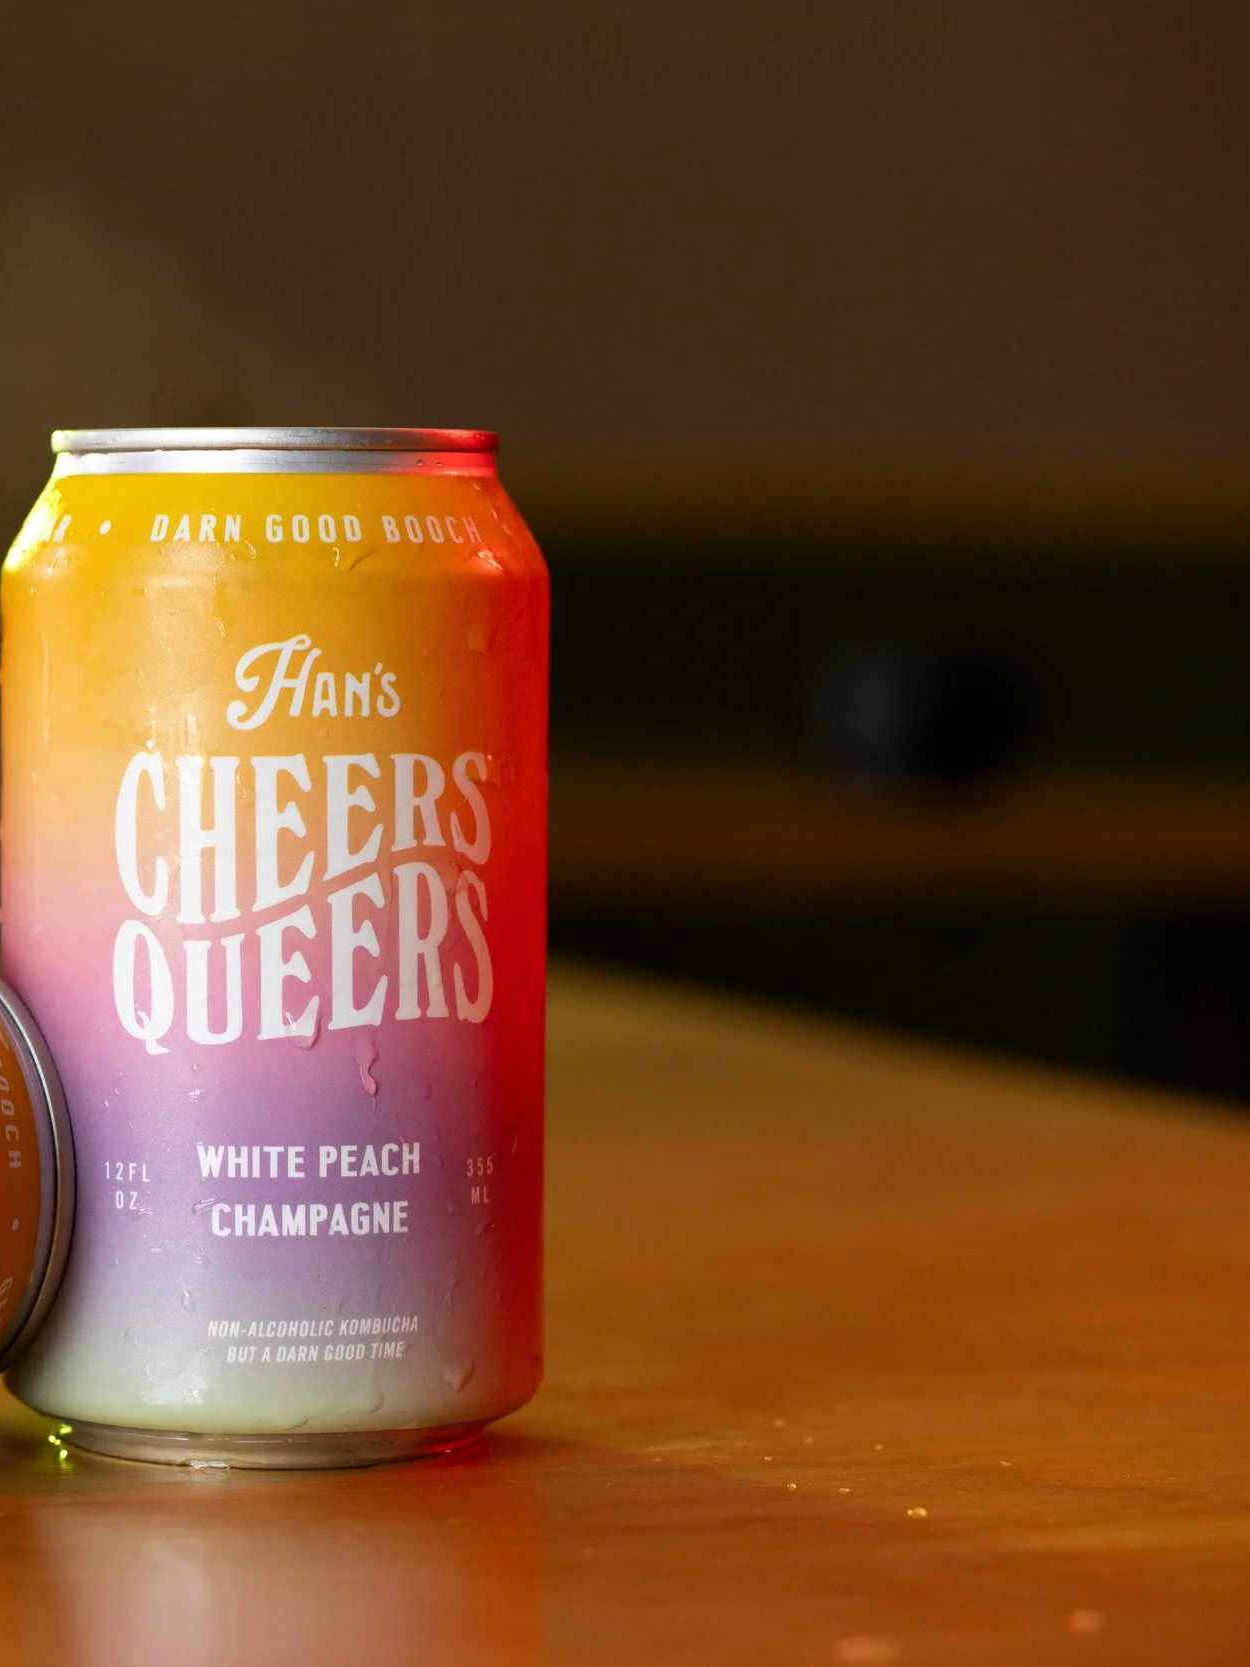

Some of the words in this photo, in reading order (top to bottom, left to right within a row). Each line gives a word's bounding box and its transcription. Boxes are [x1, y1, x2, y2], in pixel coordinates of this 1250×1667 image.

[150, 513, 242, 544] DARN
[265, 513, 362, 544] GOOD
[381, 513, 484, 545] BOOCH
[114, 751, 492, 924] CHEERS
[112, 861, 494, 1055] QUEERS
[197, 1144, 305, 1179] WHITE
[319, 1142, 421, 1178] PEACH
[466, 1156, 494, 1178] 355
[471, 1185, 490, 1205] ML
[211, 1201, 410, 1238] CHAMPAGNE
[207, 1319, 334, 1339] NON-ALCOHOLIC
[338, 1315, 419, 1337] KOMBUCHA
[226, 1345, 257, 1363] BUT
[261, 1346, 271, 1363] A
[276, 1344, 319, 1363] DARN
[323, 1343, 366, 1361] GOOD
[370, 1341, 406, 1360] TIME
